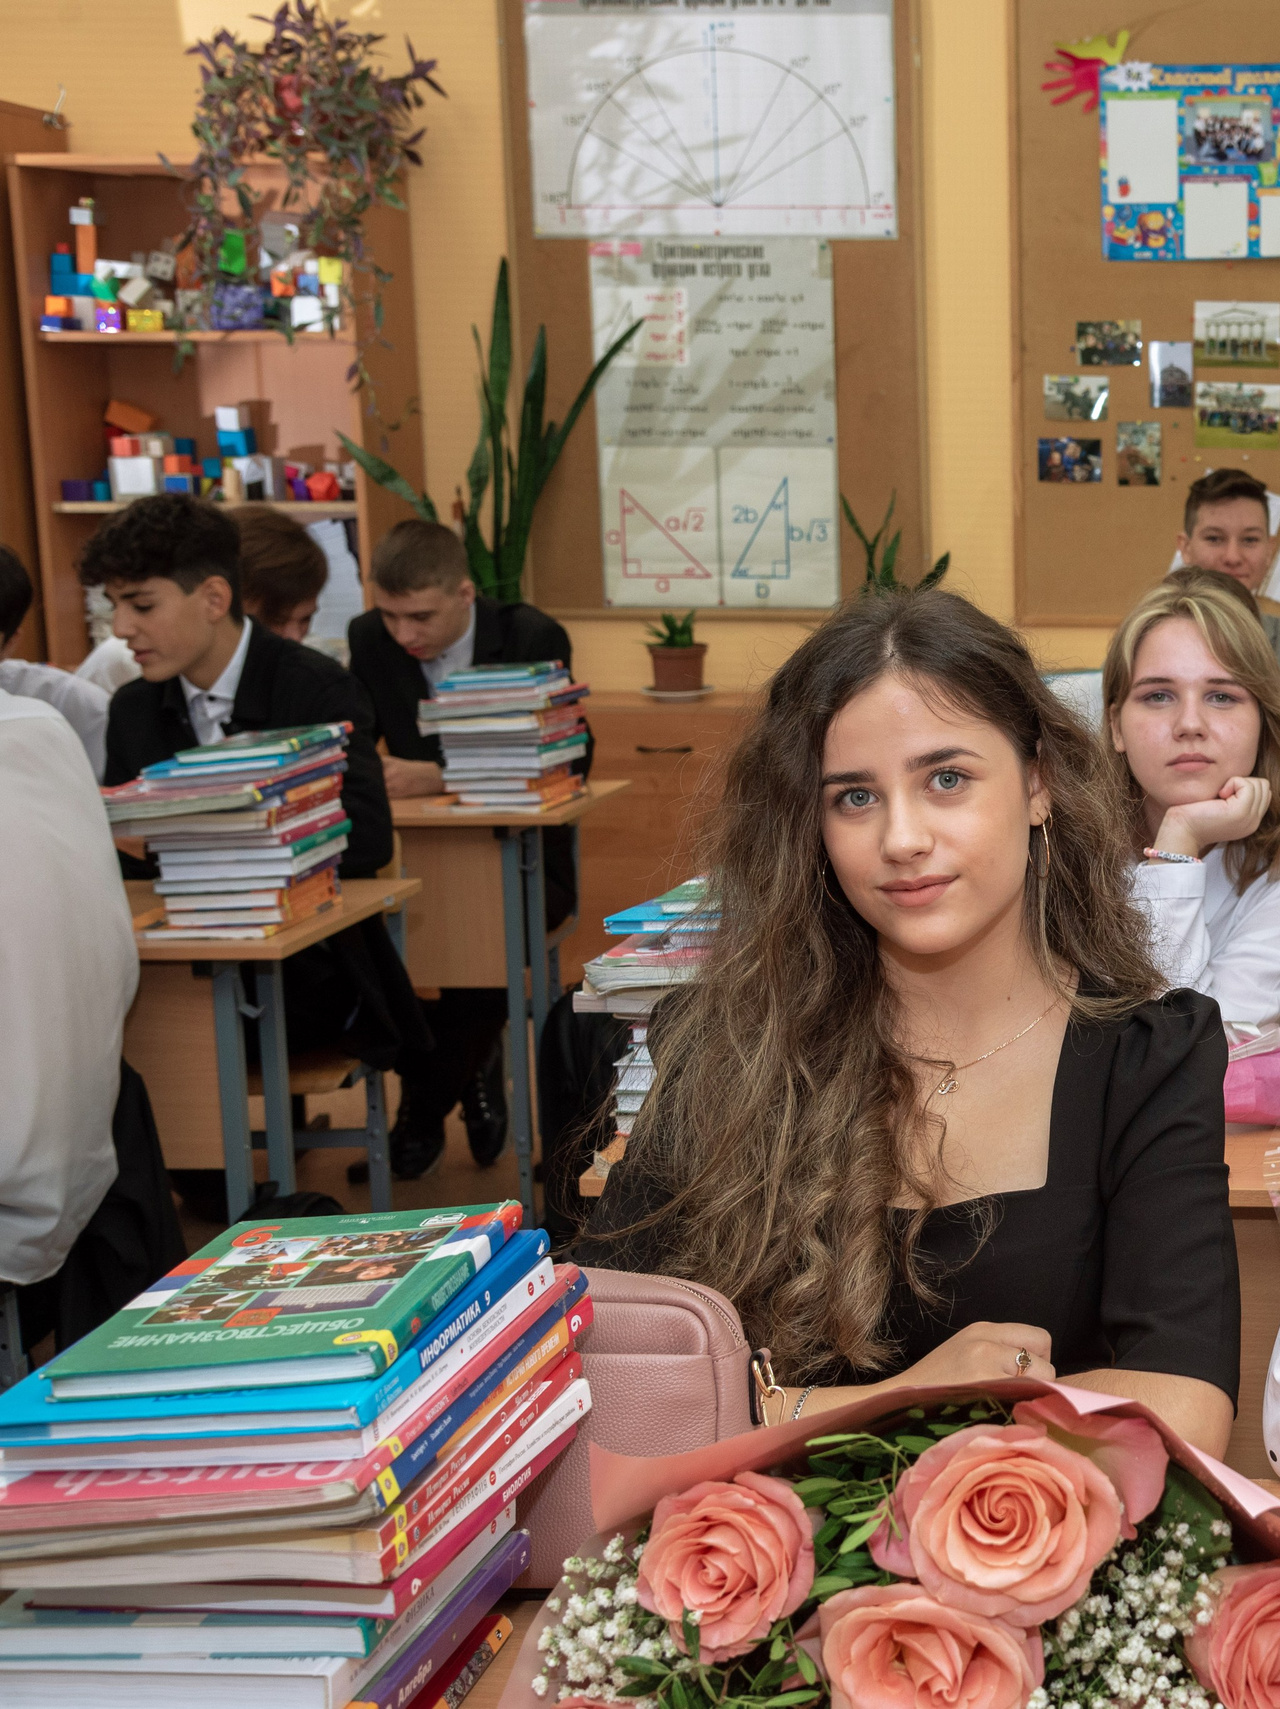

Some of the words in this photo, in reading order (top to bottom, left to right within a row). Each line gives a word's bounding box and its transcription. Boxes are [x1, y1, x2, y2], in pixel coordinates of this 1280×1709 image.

[112, 1317, 365, 1348] ОБЩЕСТВОЗНАНИЕ
[420, 1299, 482, 1368] ИНФОРМАТИКА
[484, 1290, 491, 1306] 9
[525, 1347, 542, 1371] НОВОГО
[541, 1332, 560, 1357] ВРЕМЕНИ
[425, 1394, 450, 1422] HORIZONTE
[426, 1472, 449, 1499] История
[451, 1453, 467, 1475] России
[428, 1497, 451, 1526] История
[453, 1477, 470, 1498] России
[519, 1411, 535, 1430] Часть
[502, 1467, 532, 1502] БИОЛОГИЯ
[452, 1478, 488, 1517] ГЕОГРАФИЯ
[404, 1587, 435, 1623] ФИЗИКА
[398, 1659, 433, 1707] Алгебра
